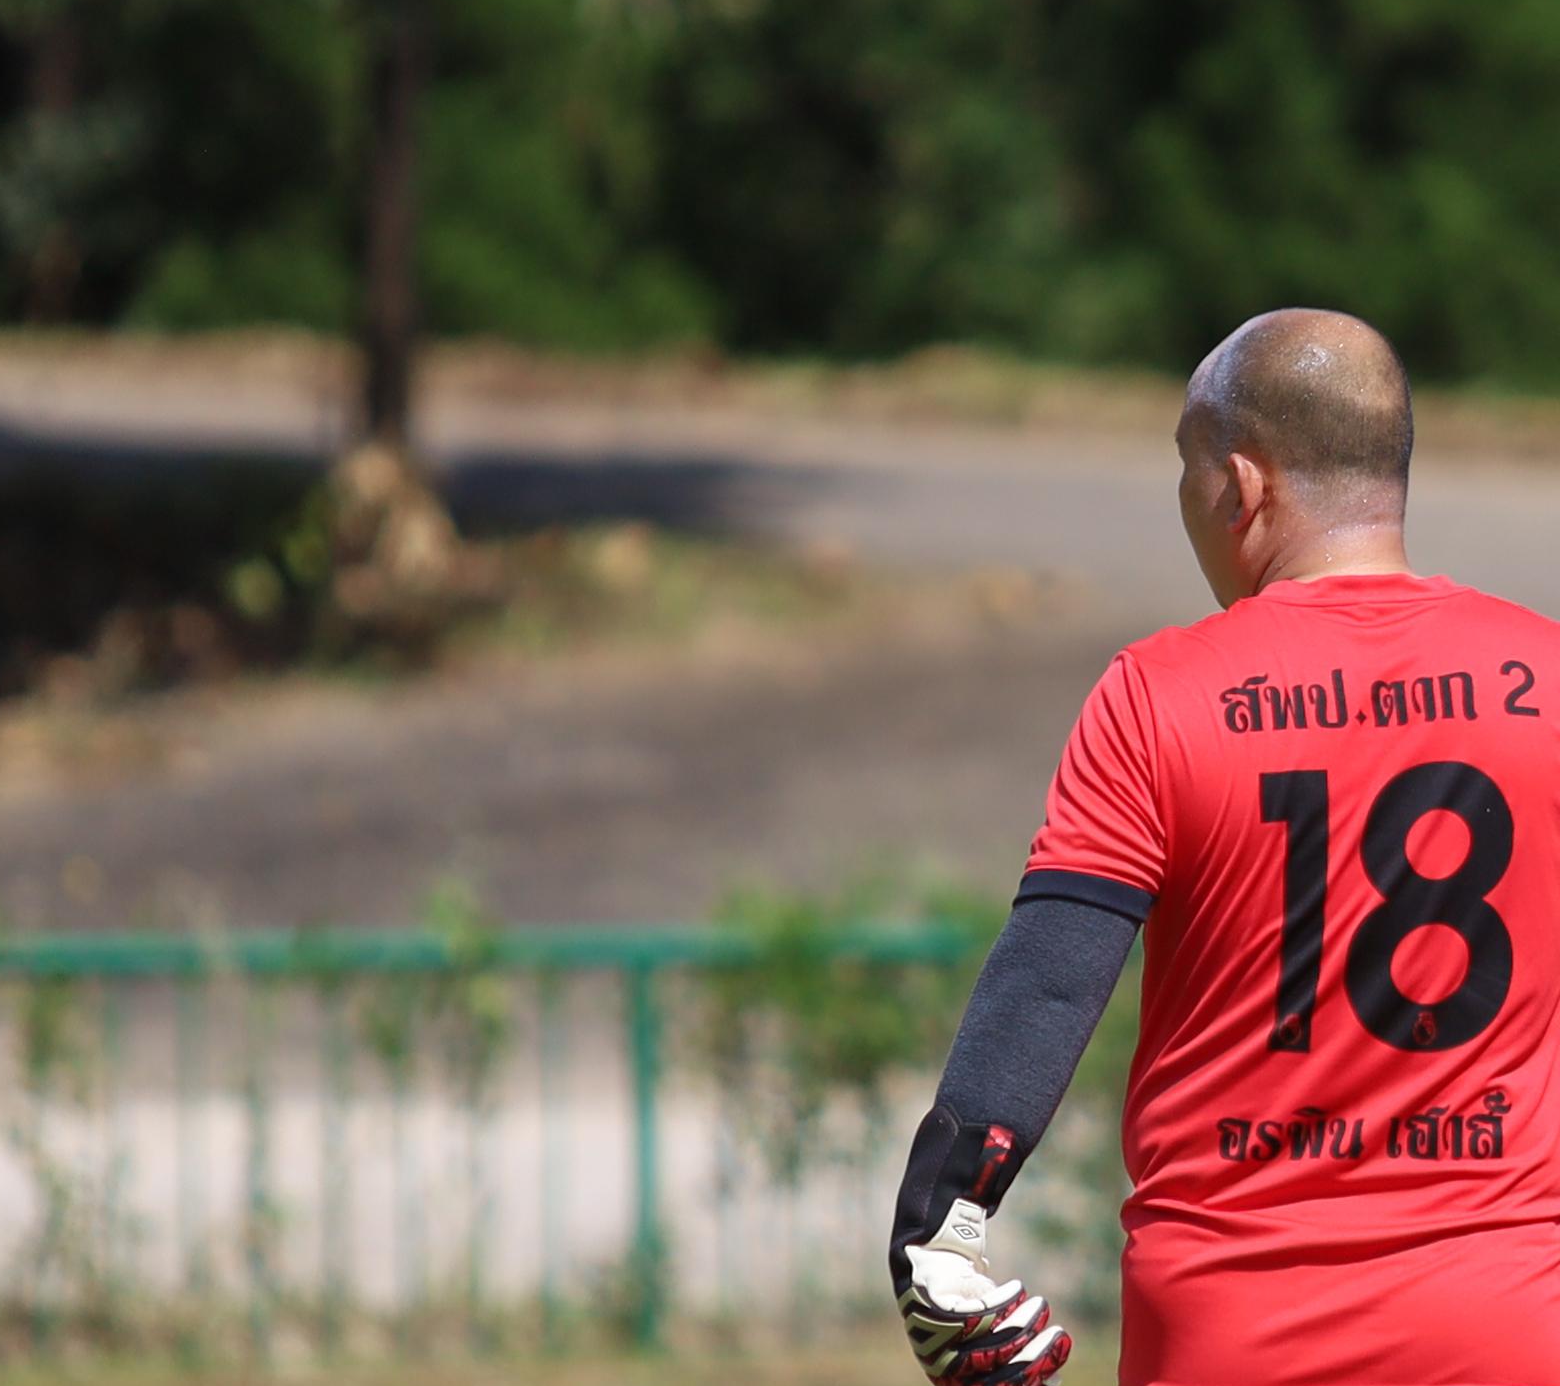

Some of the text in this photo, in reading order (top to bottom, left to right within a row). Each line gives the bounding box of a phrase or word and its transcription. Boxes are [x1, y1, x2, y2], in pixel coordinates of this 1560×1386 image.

[1219, 659, 1541, 734] สพป.ตาก 2
[1259, 761, 1515, 1054] 18
